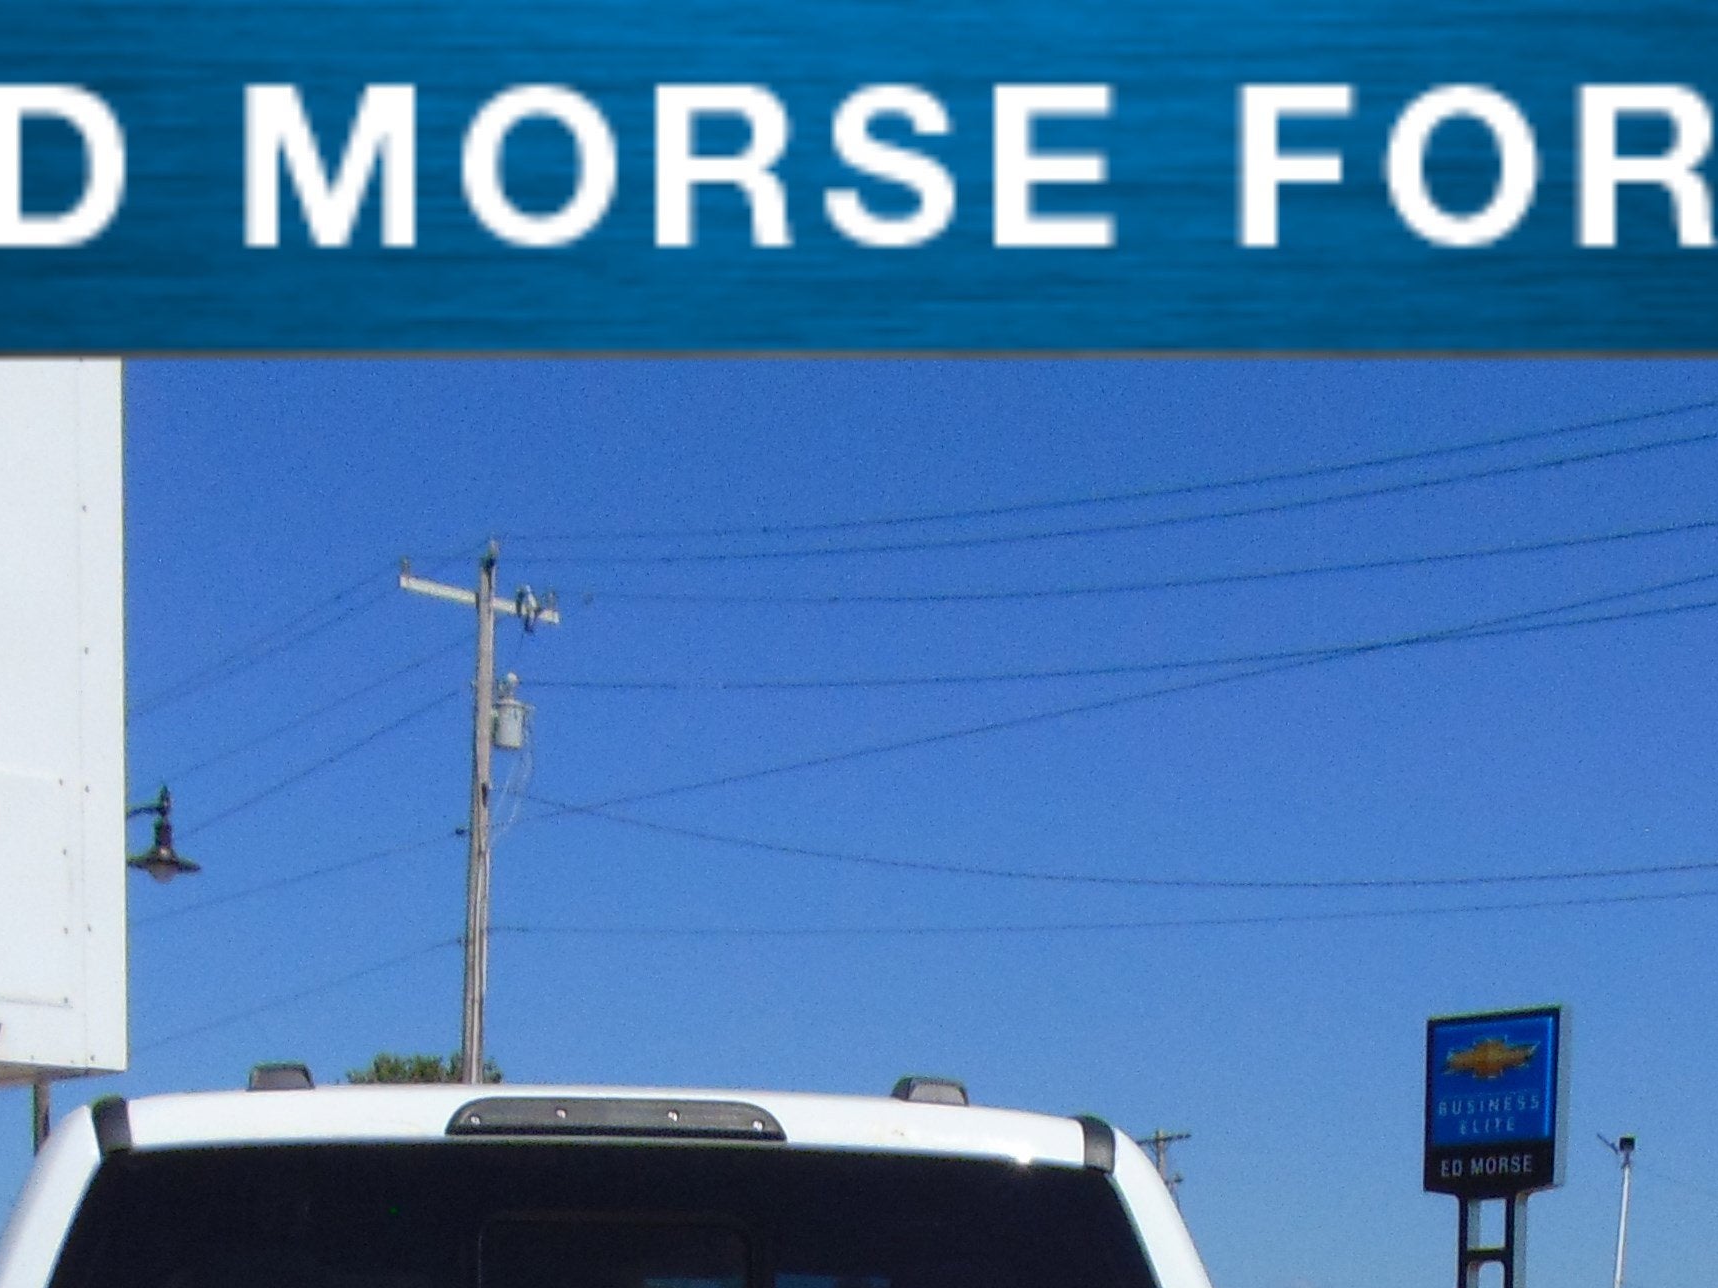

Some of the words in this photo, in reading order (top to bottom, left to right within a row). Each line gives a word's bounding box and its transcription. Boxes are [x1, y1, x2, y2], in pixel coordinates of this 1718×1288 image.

[1437, 1093, 1540, 1117] BUSINESS
[1459, 1117, 1516, 1136] ELITE
[1440, 1157, 1462, 1178] ED
[1470, 1154, 1533, 1176] MORSE
